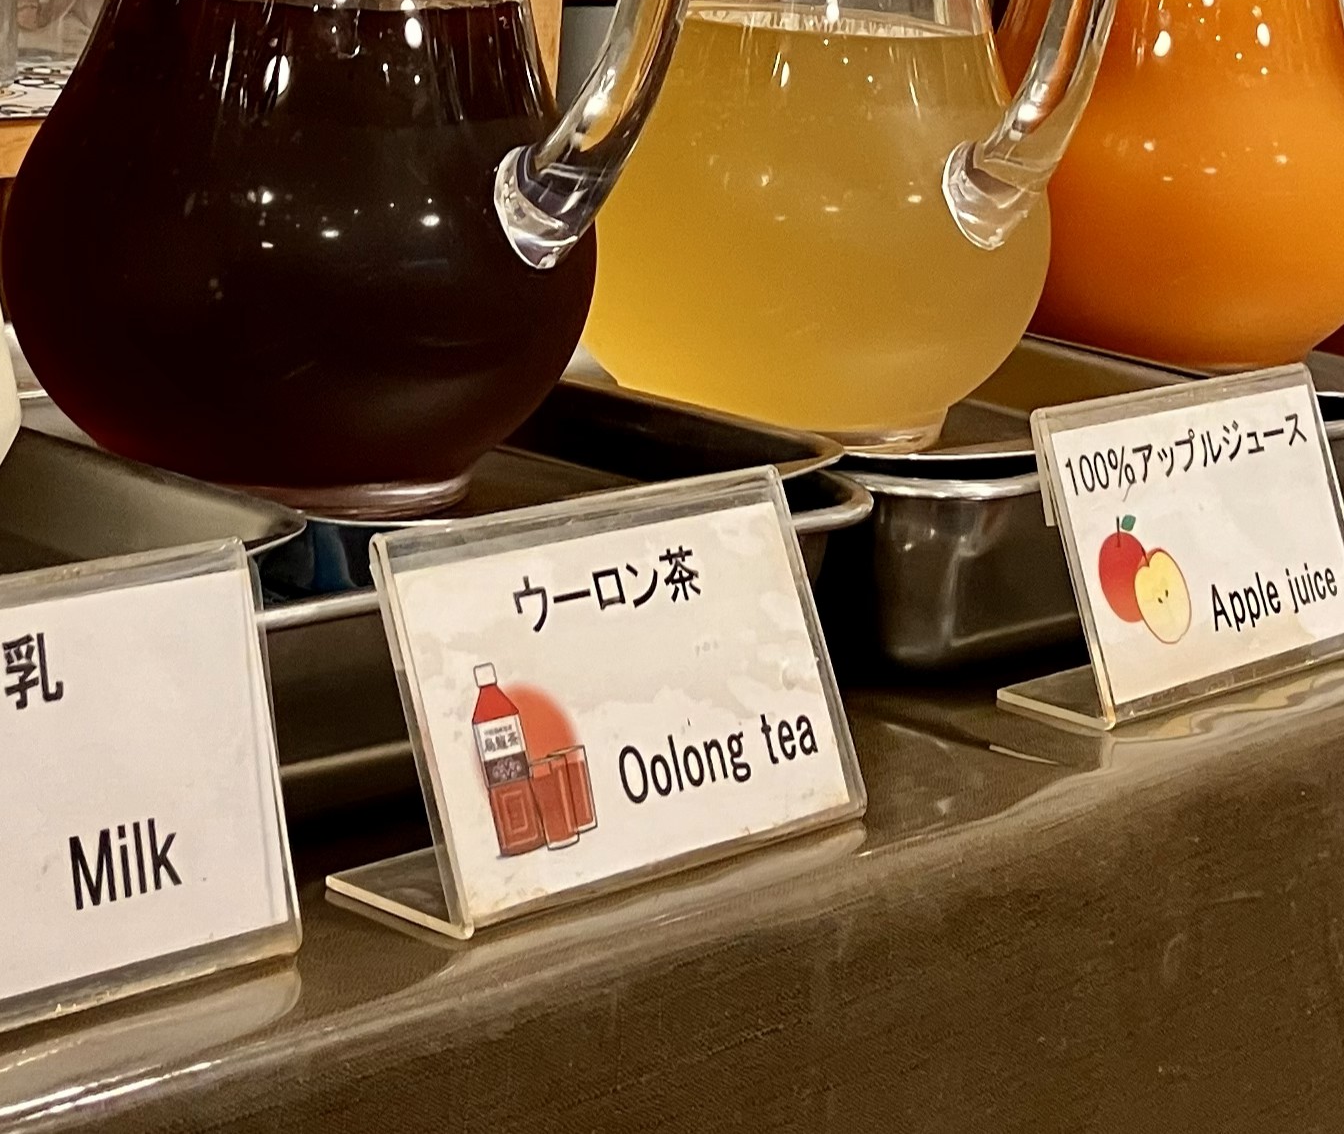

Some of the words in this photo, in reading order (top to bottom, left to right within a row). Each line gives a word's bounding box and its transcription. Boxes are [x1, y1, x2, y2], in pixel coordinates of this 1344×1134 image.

[1064, 413, 1308, 497] 100%アップルジュース
[512, 545, 702, 633] ウーロン茶
[1210, 572, 1282, 632] Apple
[1288, 562, 1338, 613] juice
[618, 731, 752, 804] Oolong
[760, 713, 819, 766] tea
[69, 818, 183, 911] Milk
